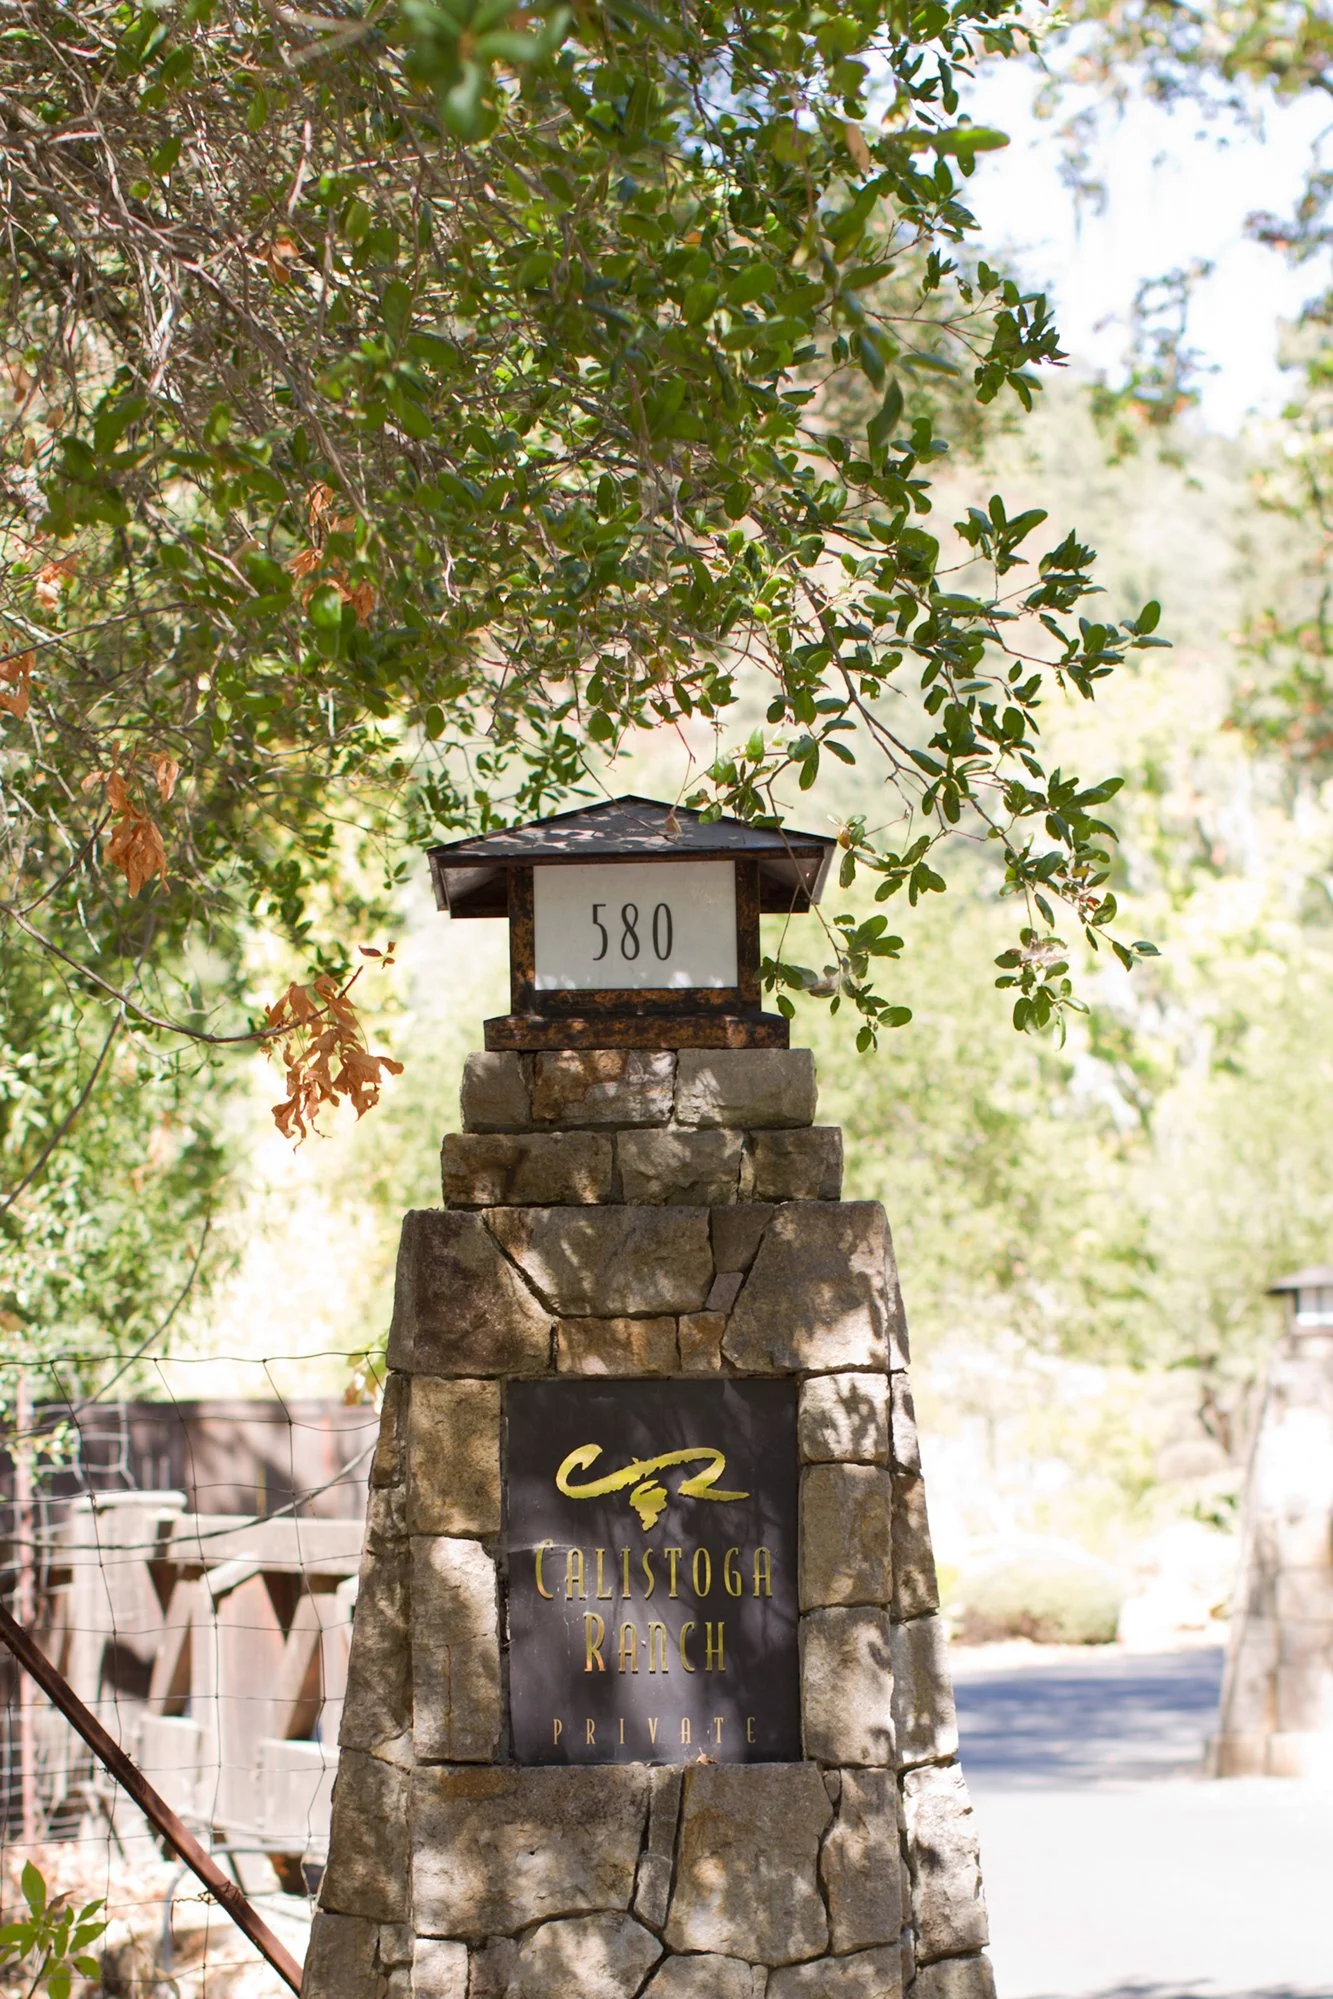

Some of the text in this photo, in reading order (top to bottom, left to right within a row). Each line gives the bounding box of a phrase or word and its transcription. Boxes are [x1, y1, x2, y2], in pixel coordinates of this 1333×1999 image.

[591, 902, 673, 961] 580
[534, 1538, 773, 1600] CALISTOGA
[583, 1612, 727, 1674] RANCH
[552, 1716, 756, 1745] PRIVATE
